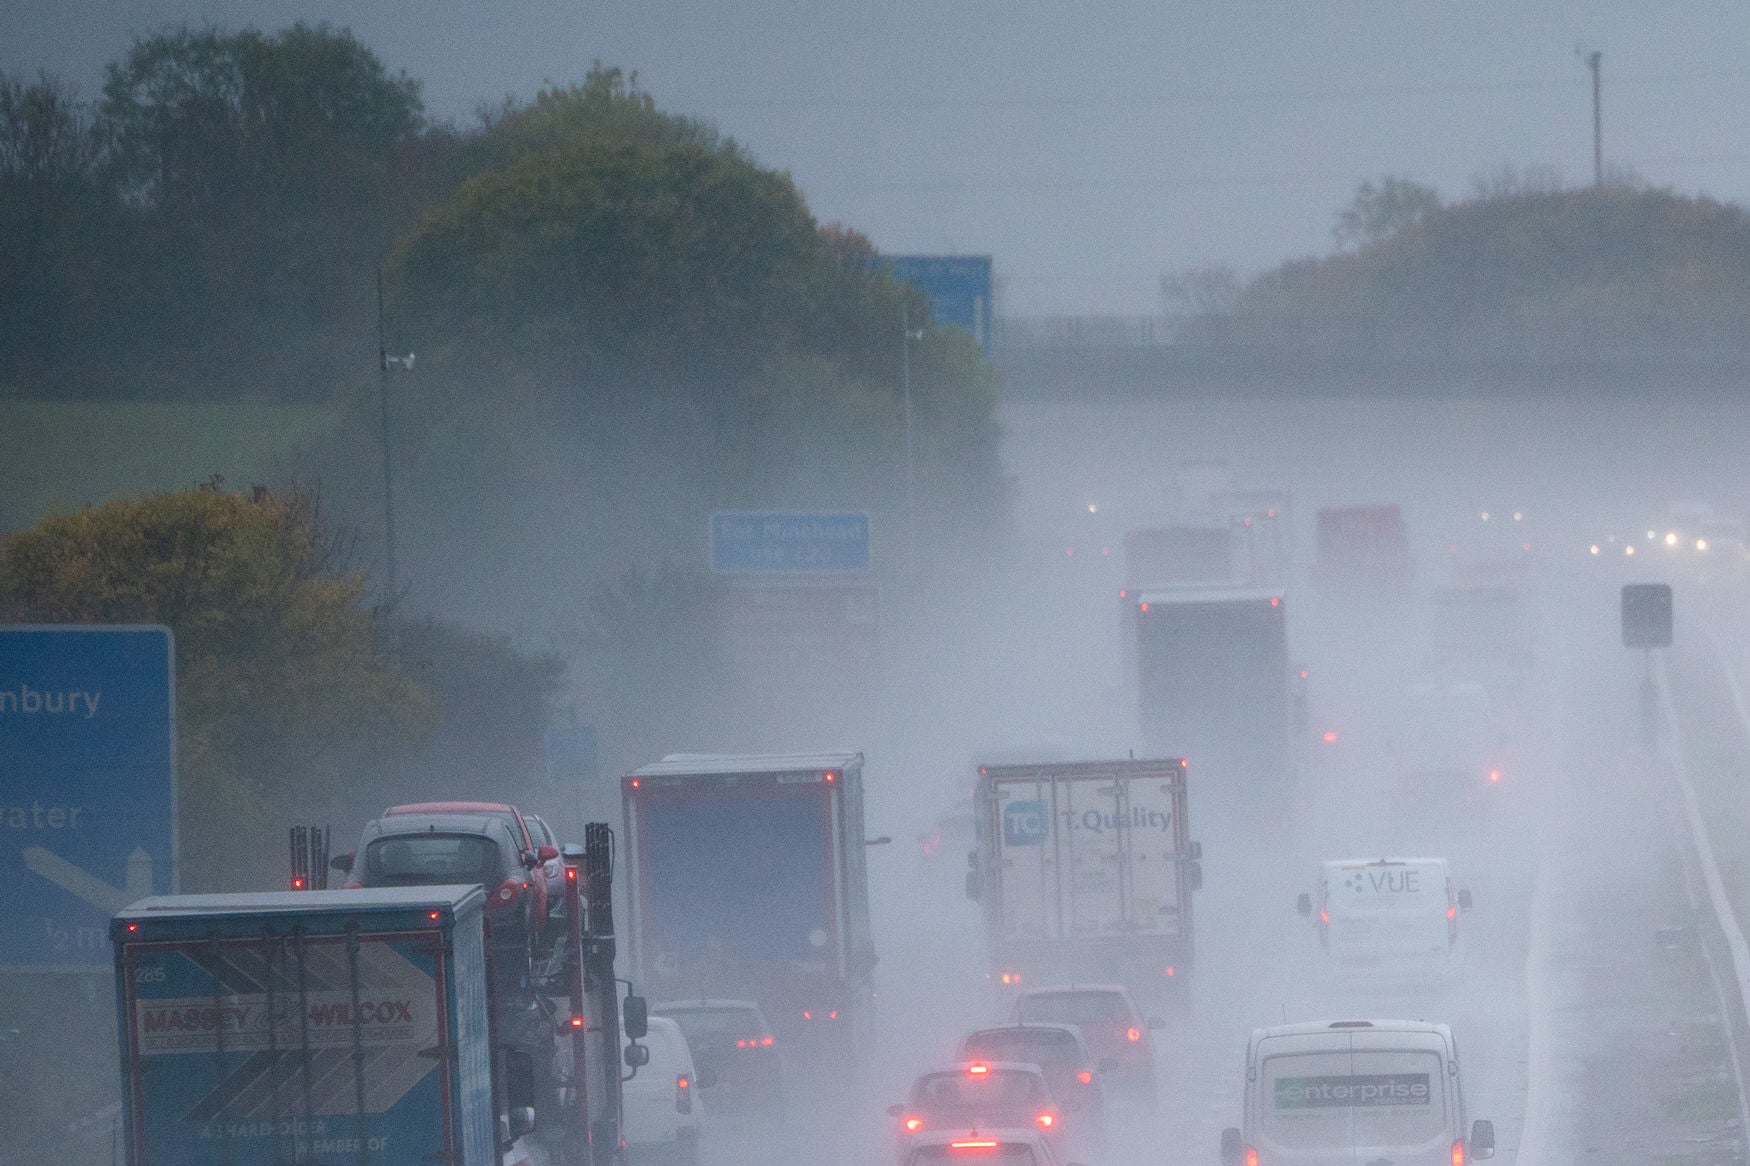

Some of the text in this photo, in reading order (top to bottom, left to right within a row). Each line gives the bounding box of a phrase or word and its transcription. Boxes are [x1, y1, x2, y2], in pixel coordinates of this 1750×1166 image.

[1368, 870, 1420, 893] VUE
[143, 1007, 250, 1032] MASSEY
[1277, 1079, 1428, 1102] enterprise
